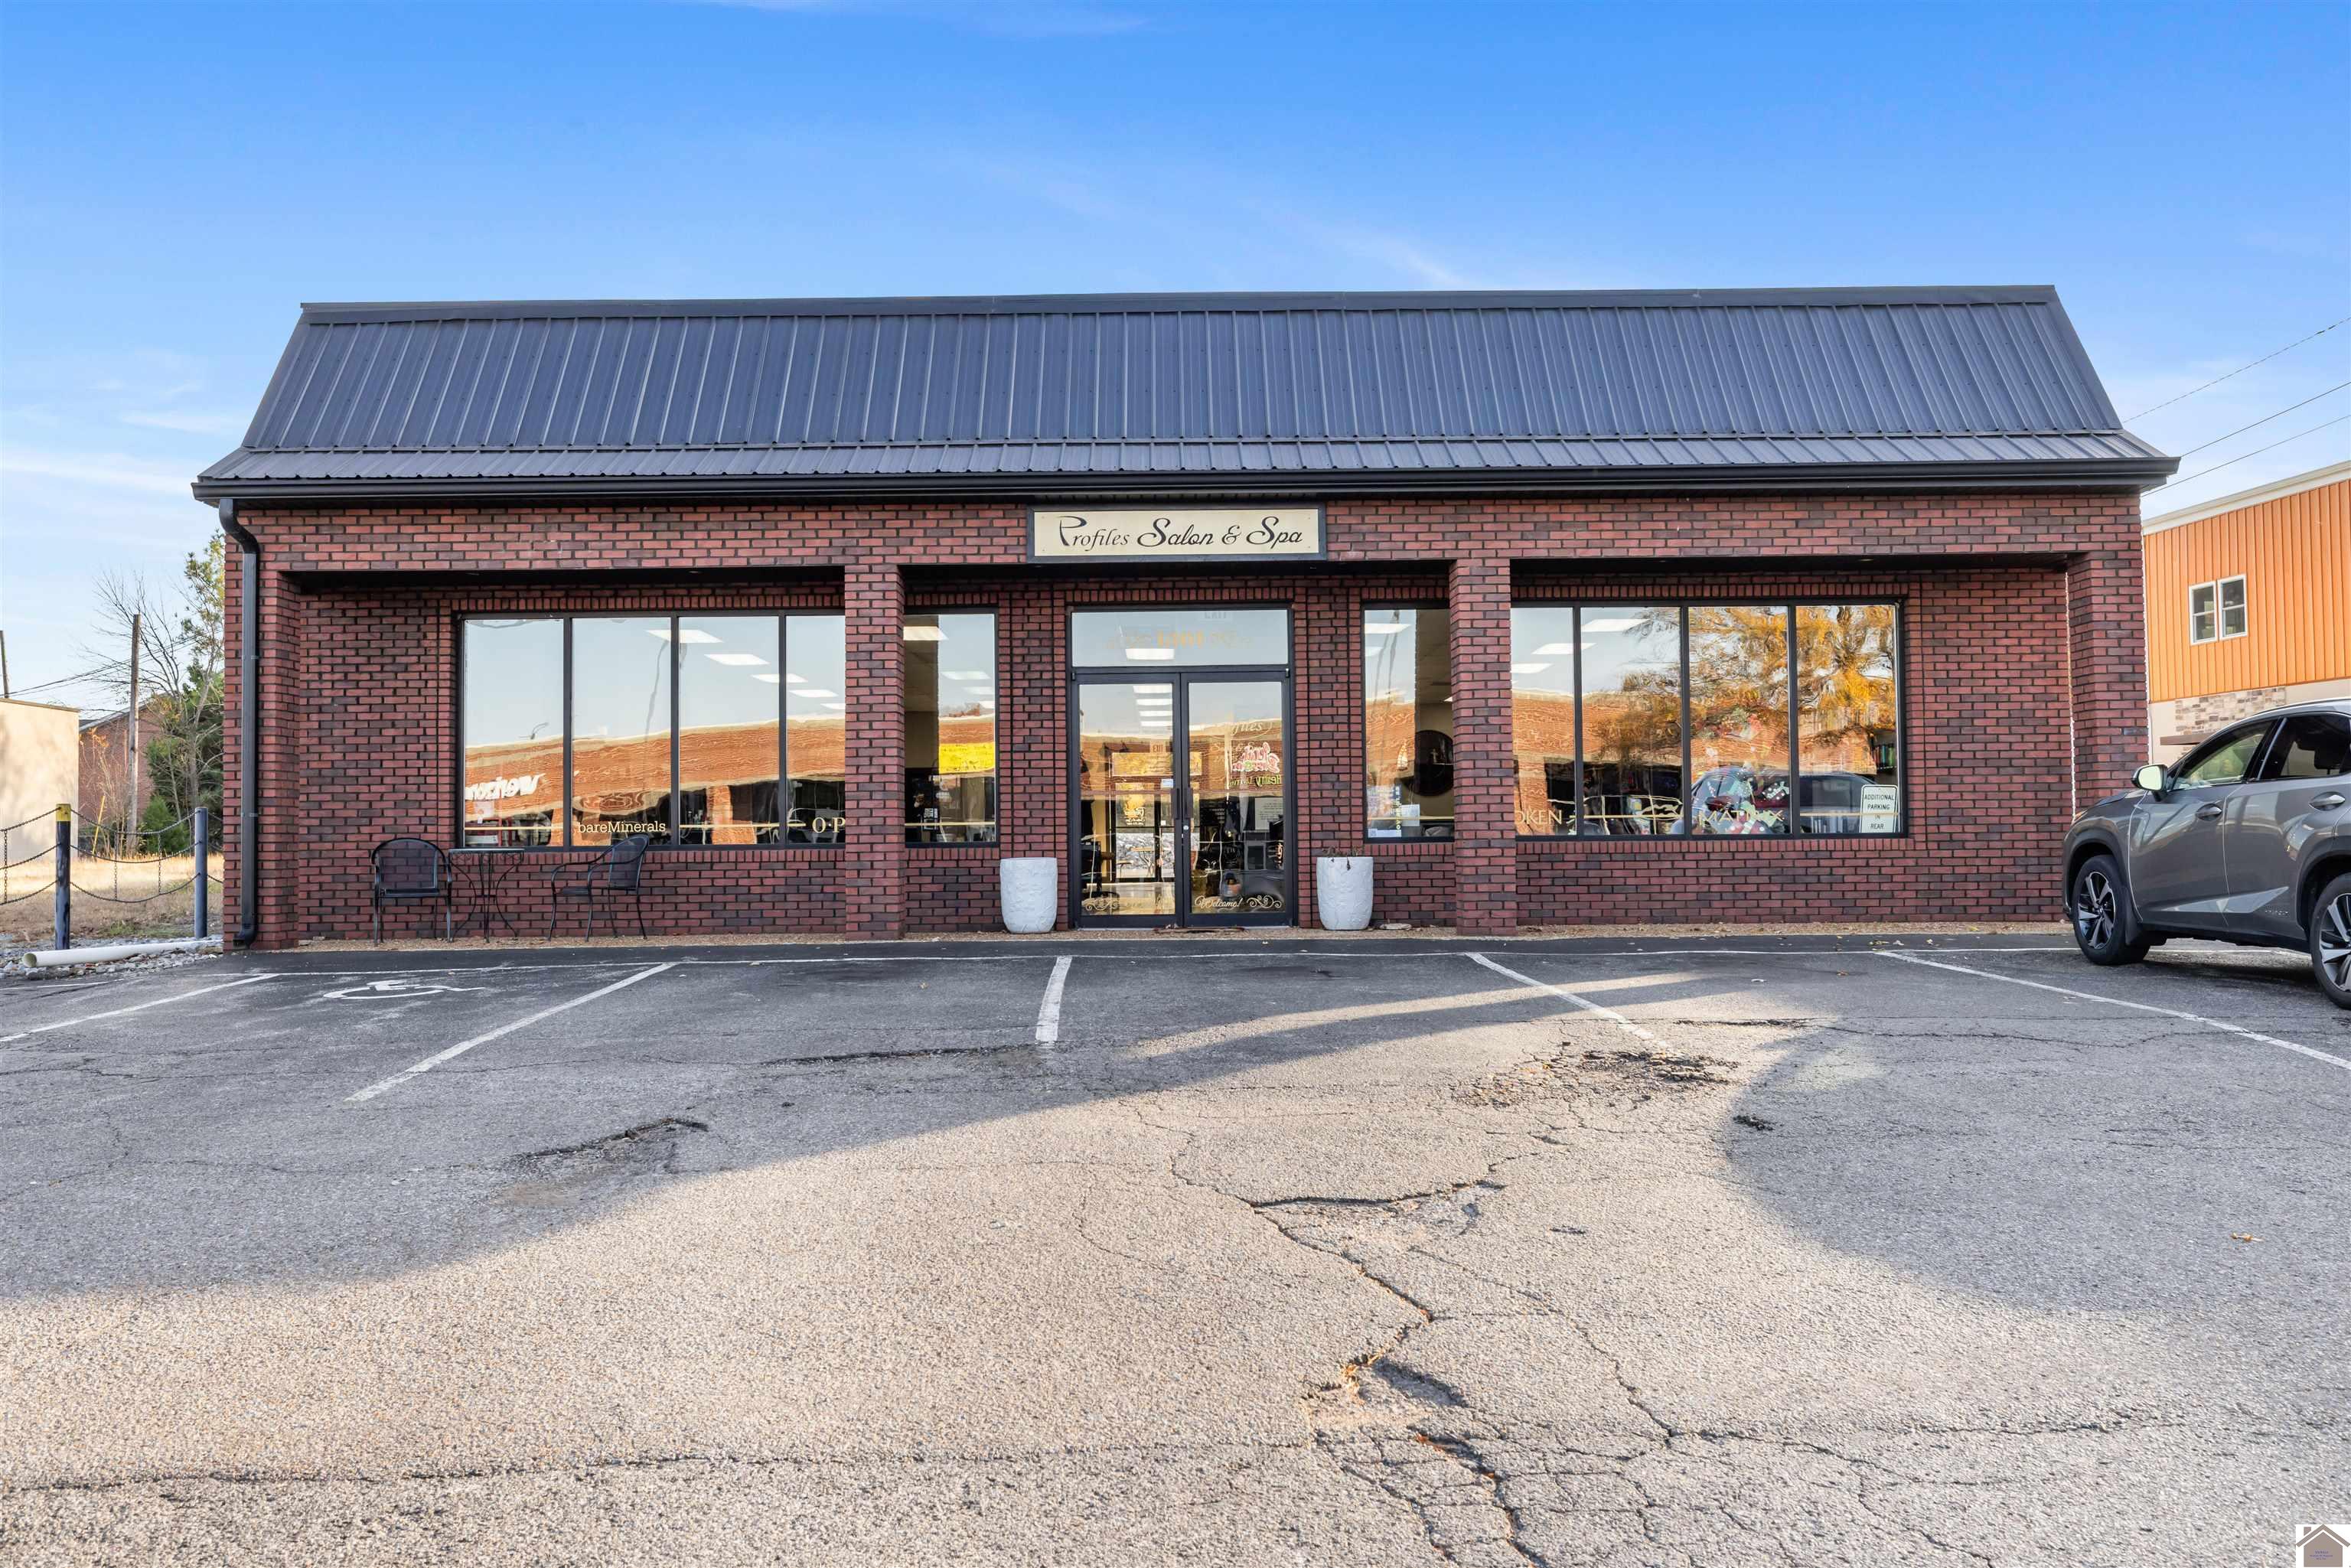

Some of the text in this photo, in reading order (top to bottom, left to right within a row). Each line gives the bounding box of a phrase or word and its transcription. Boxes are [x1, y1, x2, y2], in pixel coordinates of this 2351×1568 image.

[1059, 516, 1303, 551] Profiles Salon & Spa
[1698, 810, 1783, 824] MATX
[578, 820, 666, 833] bareMinerals
[1194, 895, 1244, 908] Welcome!
